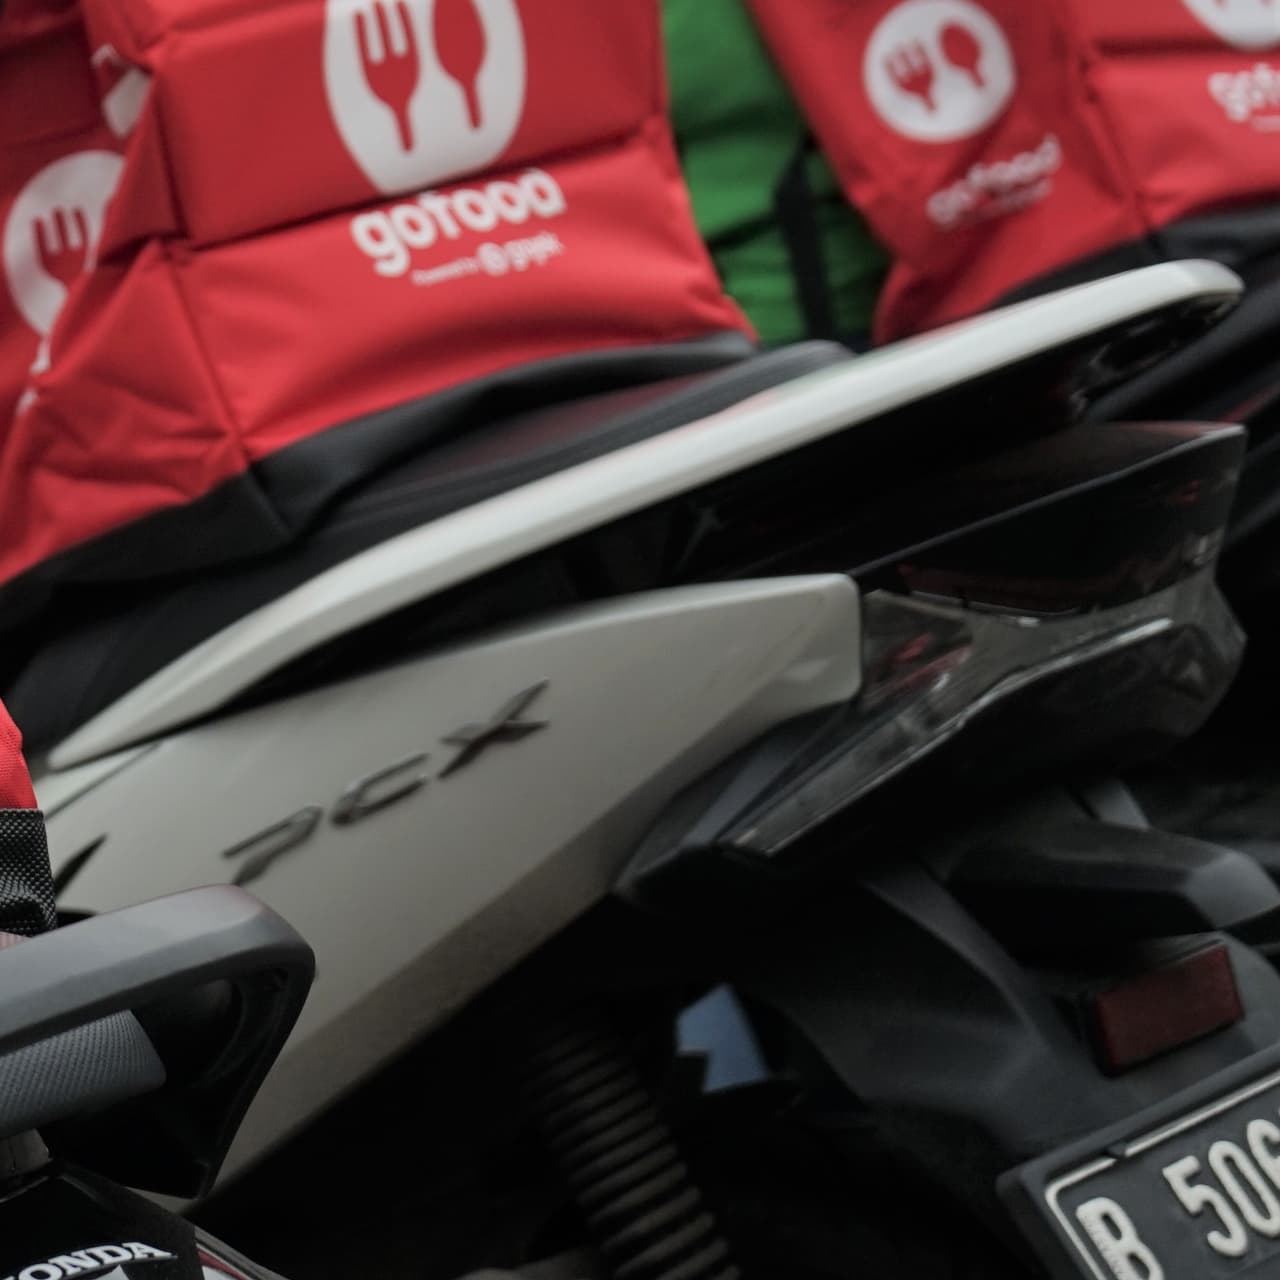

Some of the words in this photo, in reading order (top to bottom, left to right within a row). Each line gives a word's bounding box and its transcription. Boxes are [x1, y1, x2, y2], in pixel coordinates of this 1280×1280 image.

[351, 168, 567, 277] gofood
[3, 1241, 175, 1280] ONDA
[1076, 1197, 1165, 1280] B
